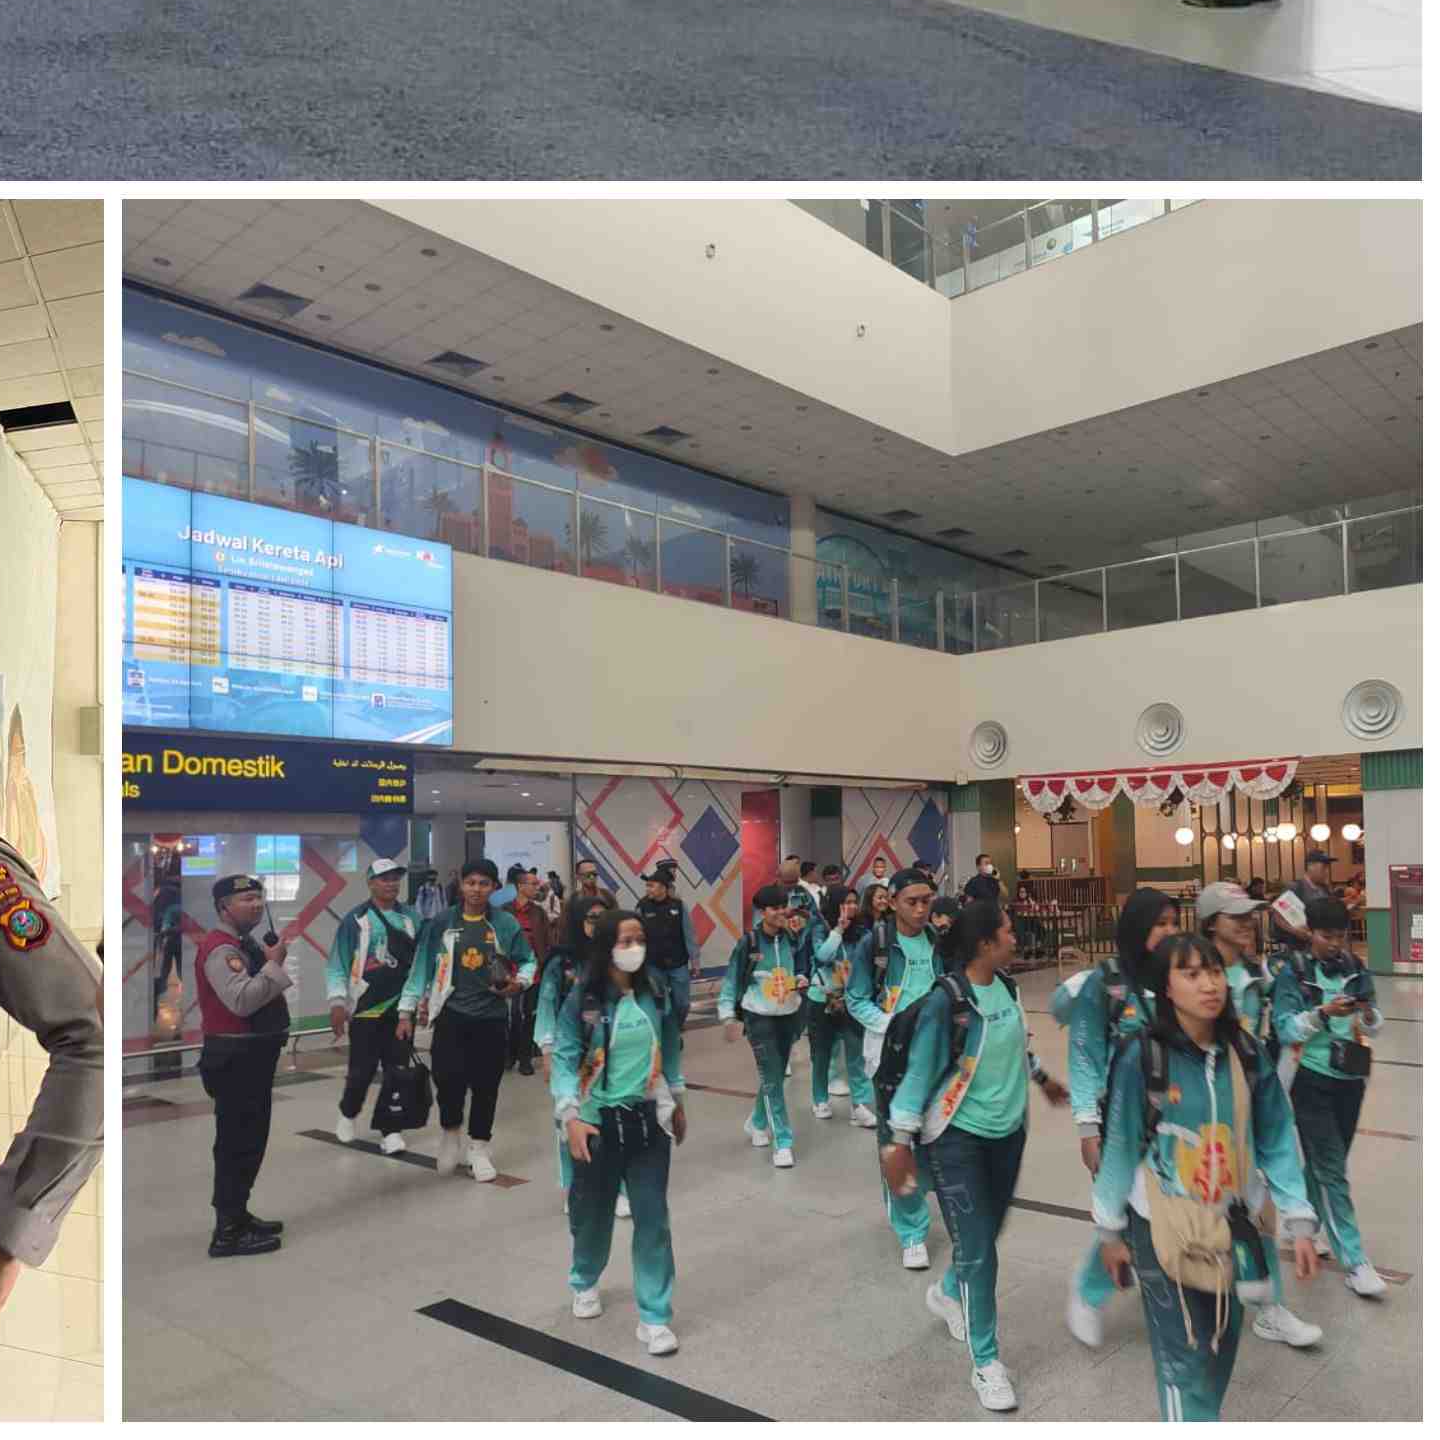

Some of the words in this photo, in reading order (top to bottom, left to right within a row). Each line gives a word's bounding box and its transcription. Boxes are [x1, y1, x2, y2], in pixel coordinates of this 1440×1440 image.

[177, 525, 248, 551] Jadwal
[252, 537, 310, 563] Kereta
[313, 549, 344, 569] Api
[162, 750, 285, 778] Domestik
